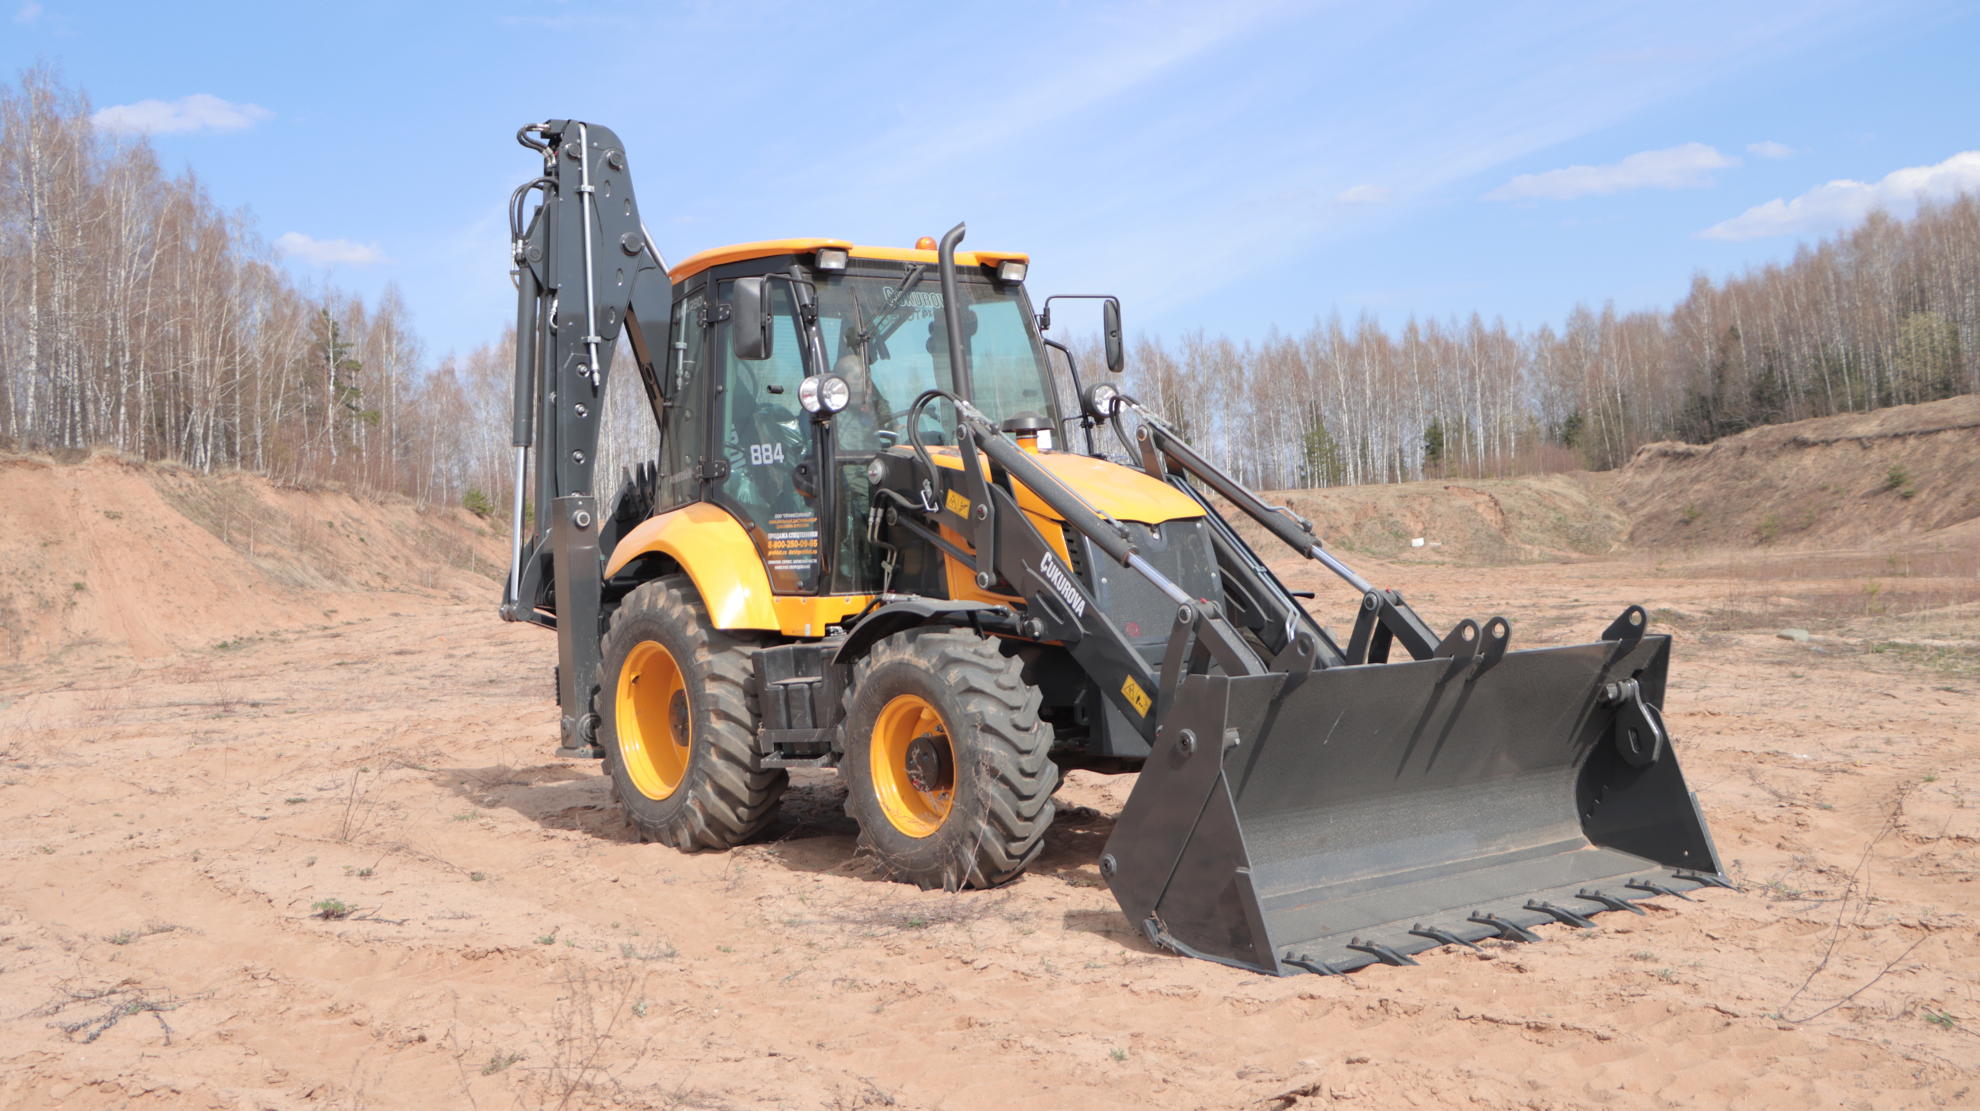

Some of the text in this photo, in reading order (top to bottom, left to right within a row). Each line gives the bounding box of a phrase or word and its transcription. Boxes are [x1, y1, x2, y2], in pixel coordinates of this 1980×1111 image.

[750, 442, 785, 466] 884
[768, 539, 818, 548] 8-800-250-09-65
[1040, 551, 1086, 618] ÇUKUROVA
